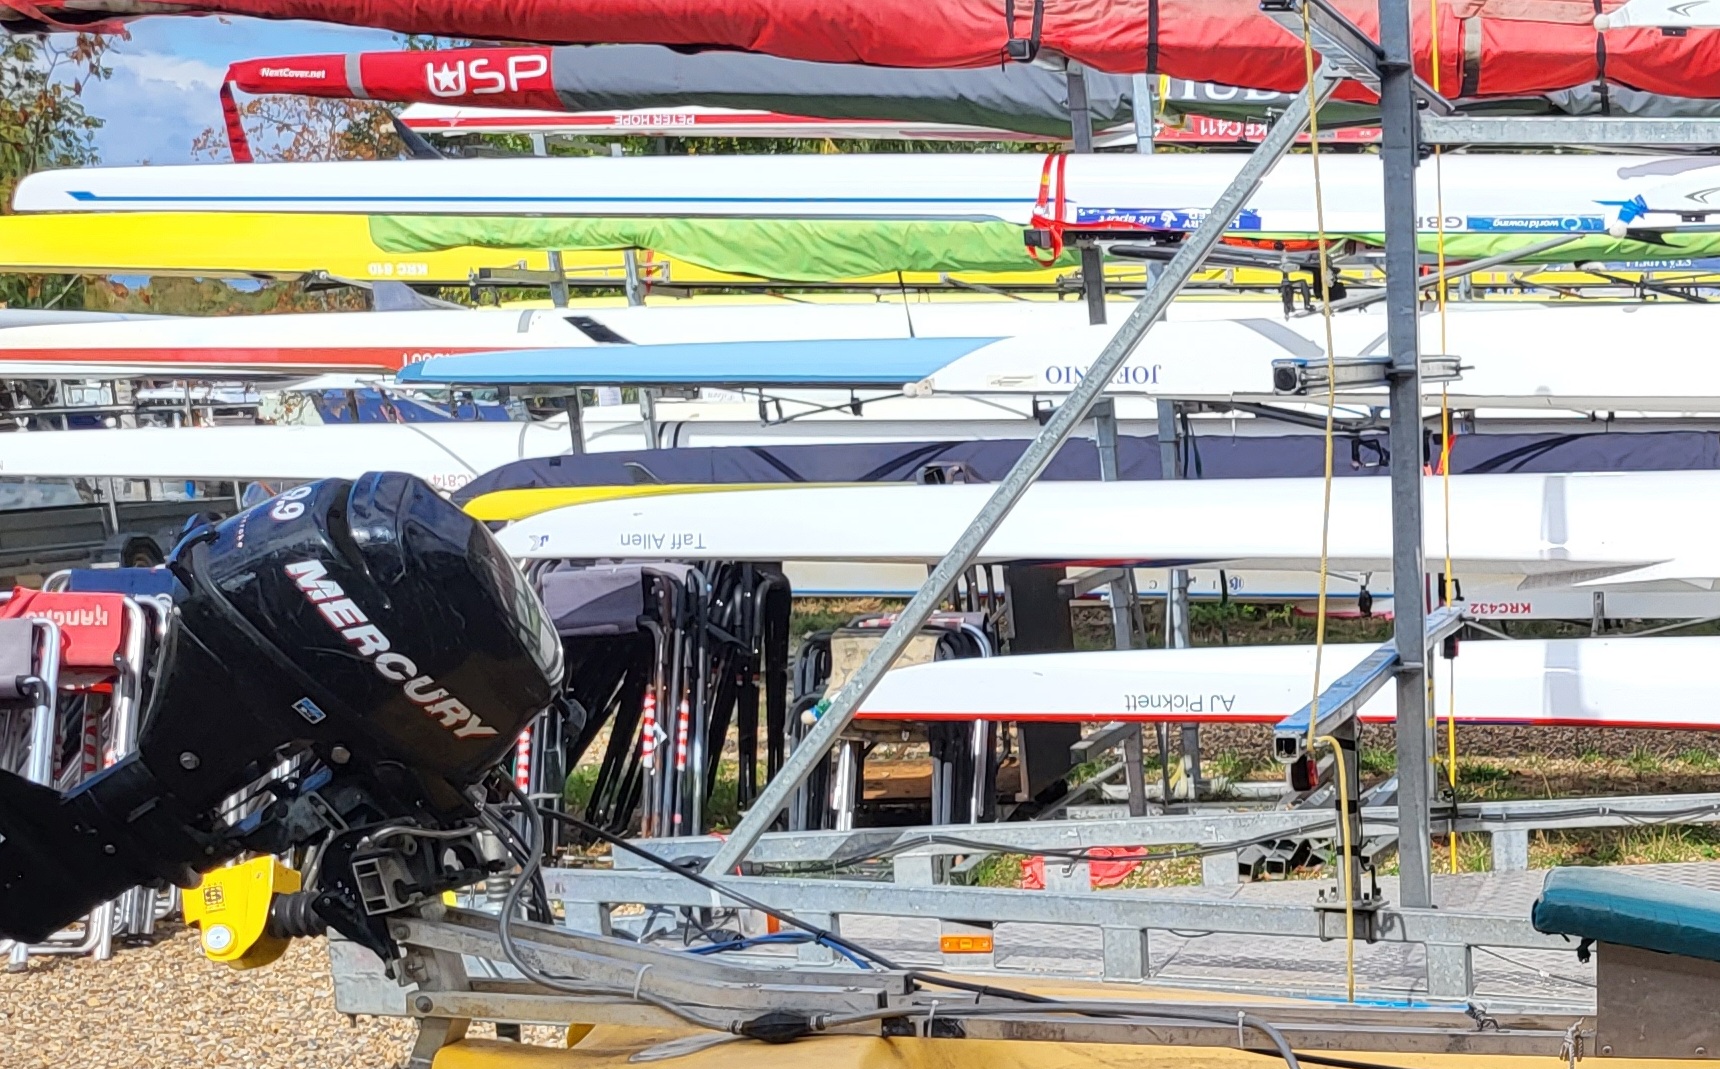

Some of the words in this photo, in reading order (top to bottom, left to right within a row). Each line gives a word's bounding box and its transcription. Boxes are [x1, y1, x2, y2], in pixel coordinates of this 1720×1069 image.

[261, 67, 326, 79] NextCover.net
[426, 55, 548, 97] USP
[615, 114, 650, 126] HOPE
[653, 114, 695, 126] PETER
[1493, 217, 1528, 228] rowing
[1529, 217, 1559, 229] world
[620, 533, 666, 550] Allen
[671, 533, 707, 550] Taff
[1470, 602, 1532, 614] KRC432
[284, 559, 500, 738] MERCURY
[1124, 694, 1203, 712] Picknett
[1210, 694, 1236, 712] AJ
